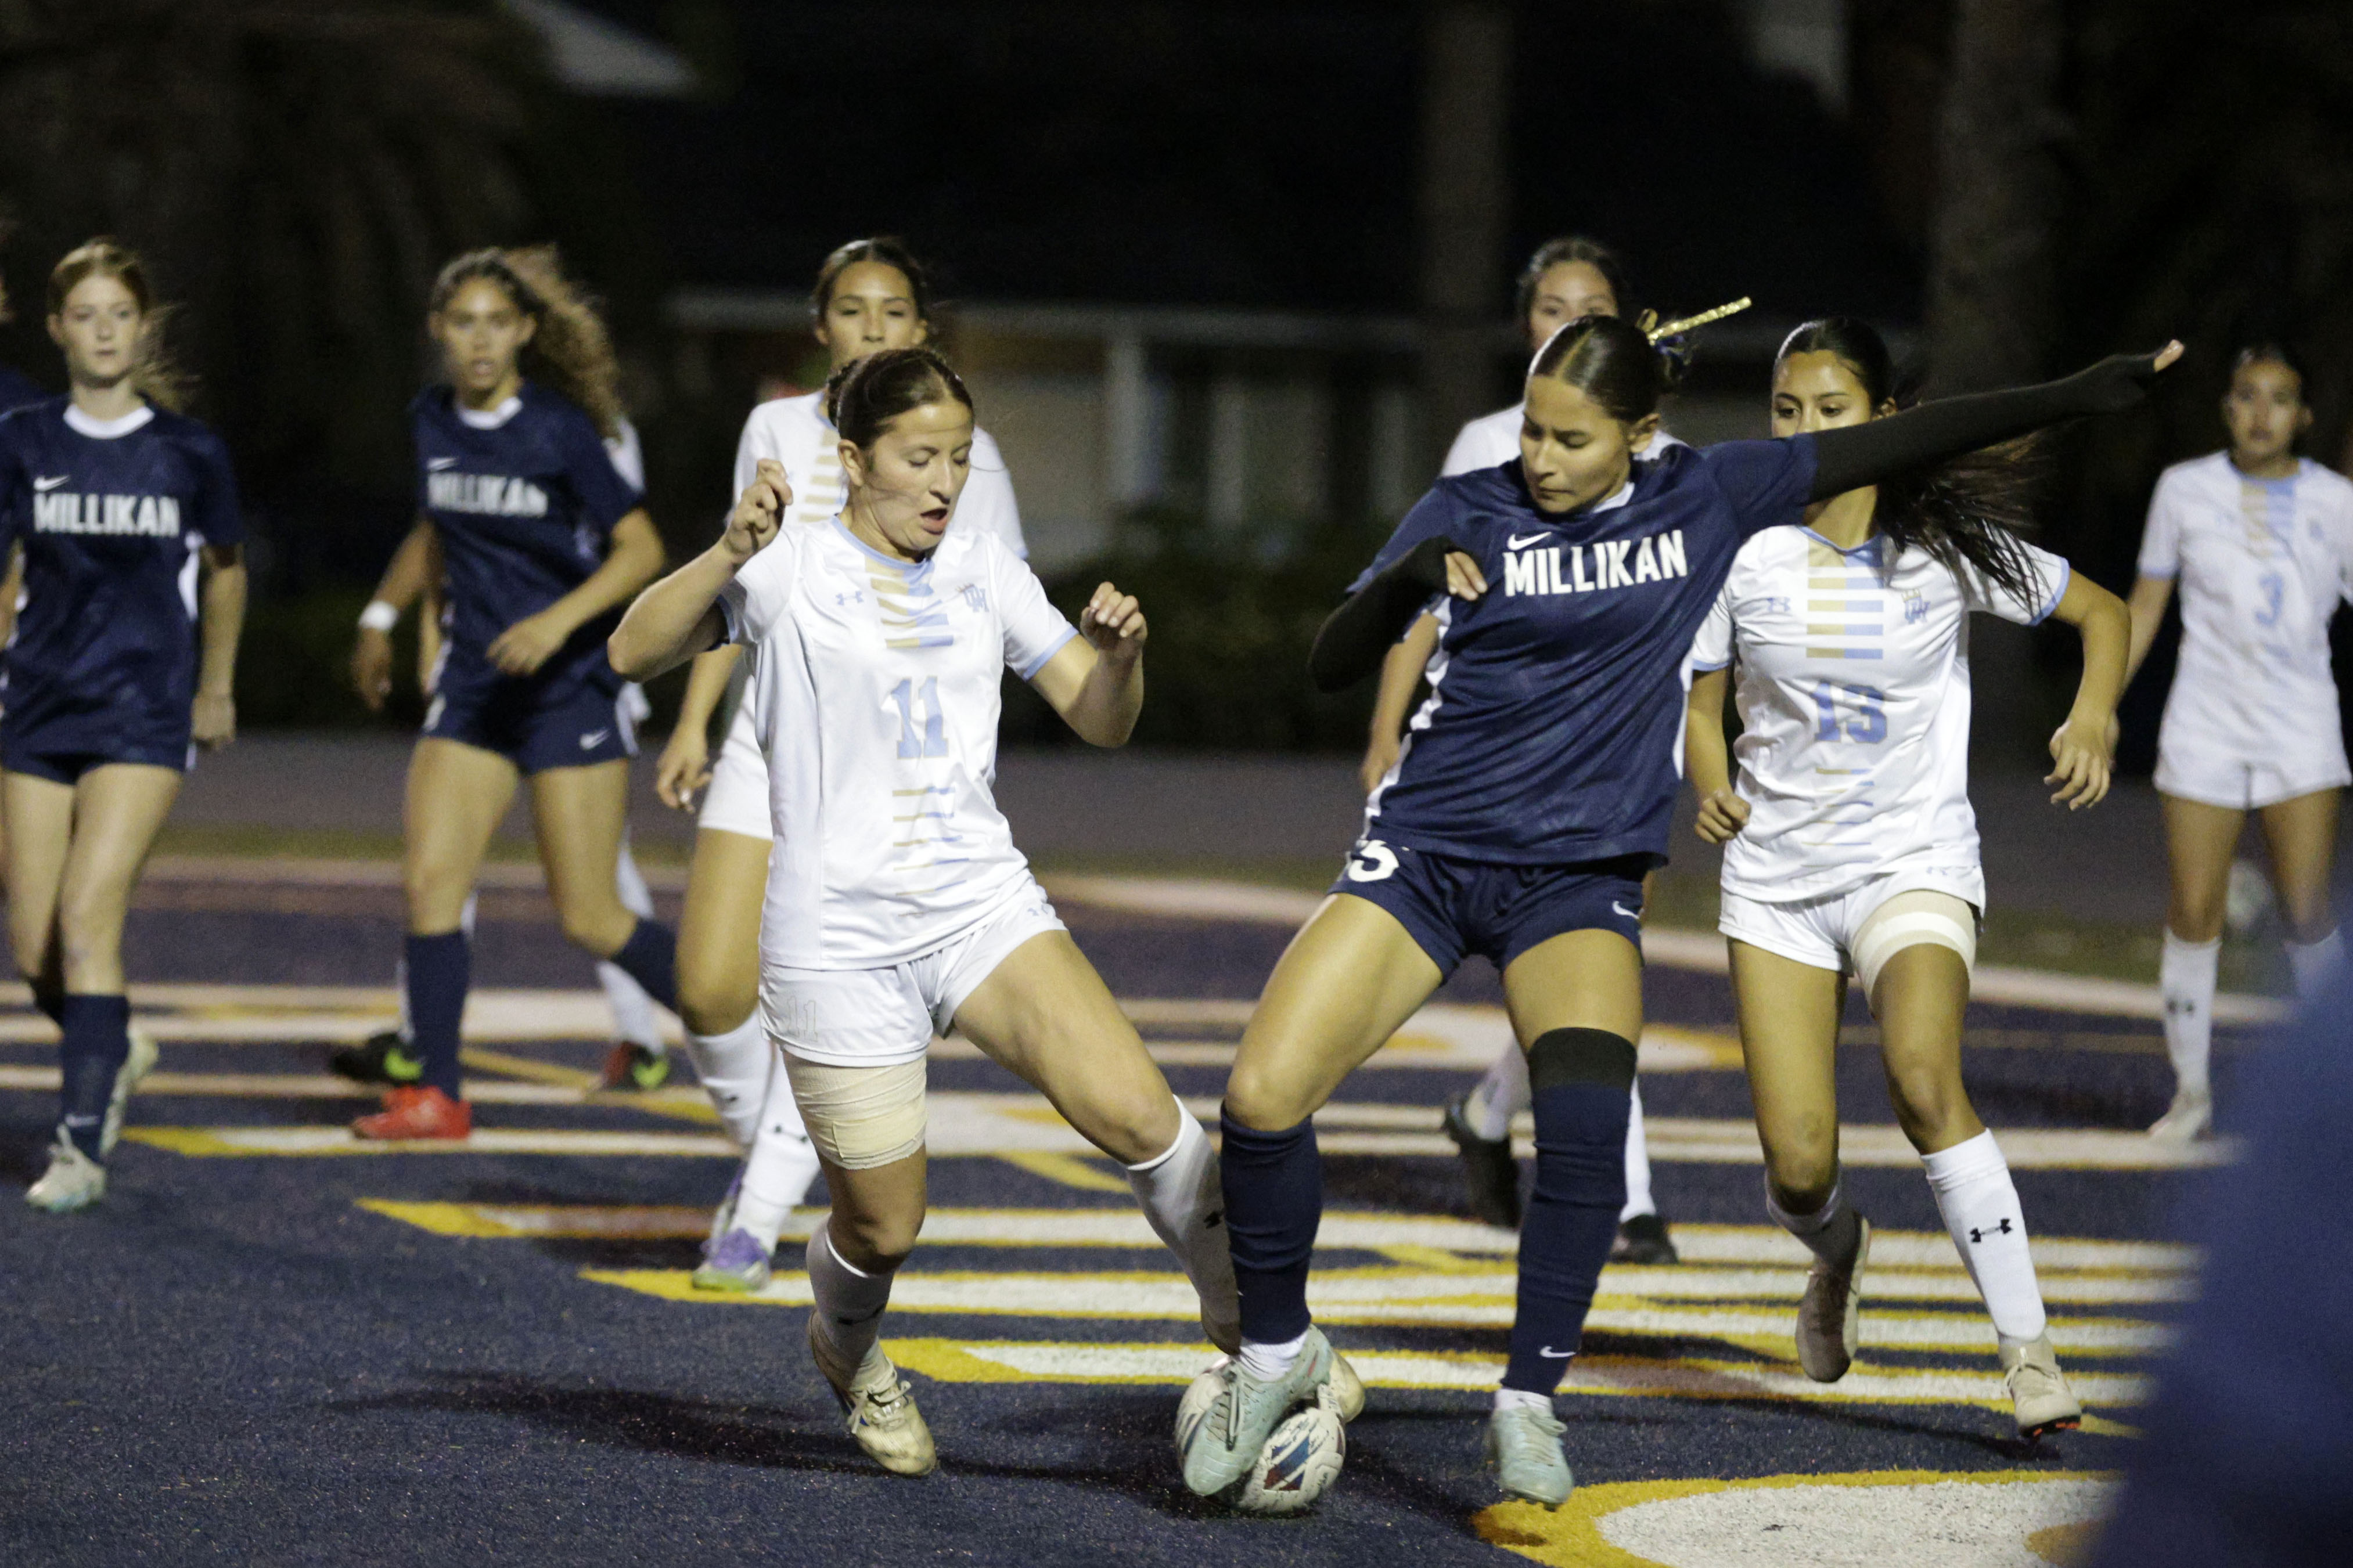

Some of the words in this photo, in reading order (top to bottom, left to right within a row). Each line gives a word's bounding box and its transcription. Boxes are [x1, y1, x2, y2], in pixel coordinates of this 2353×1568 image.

[33, 492, 180, 538] MILLIKAN
[1502, 529, 1688, 597] MILLIKAN
[891, 676, 949, 759] 11
[1812, 680, 1888, 744] 13
